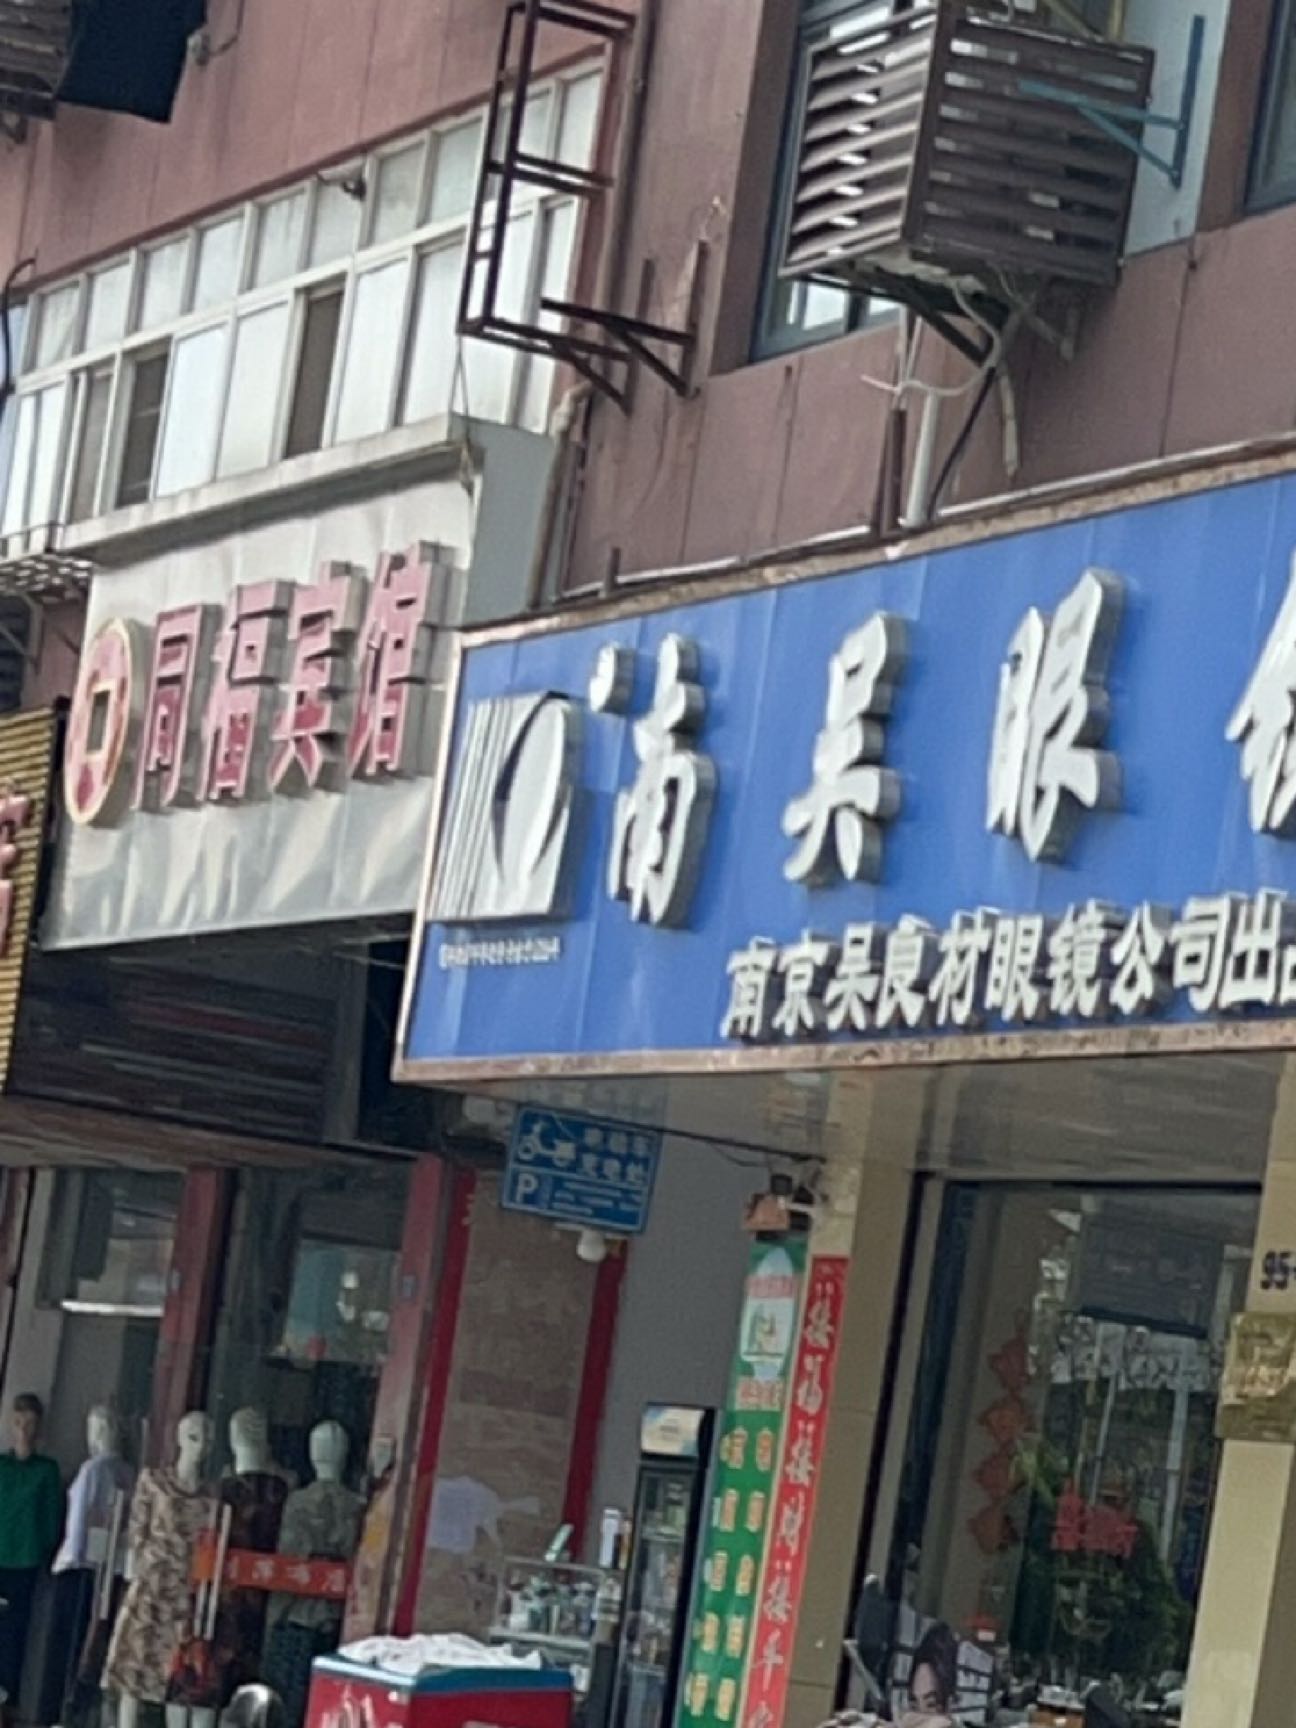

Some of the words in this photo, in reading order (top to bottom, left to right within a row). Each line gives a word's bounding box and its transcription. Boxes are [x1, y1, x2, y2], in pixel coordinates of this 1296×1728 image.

[134, 540, 430, 807] 同福宾馆
[514, 1172, 540, 1204] P
